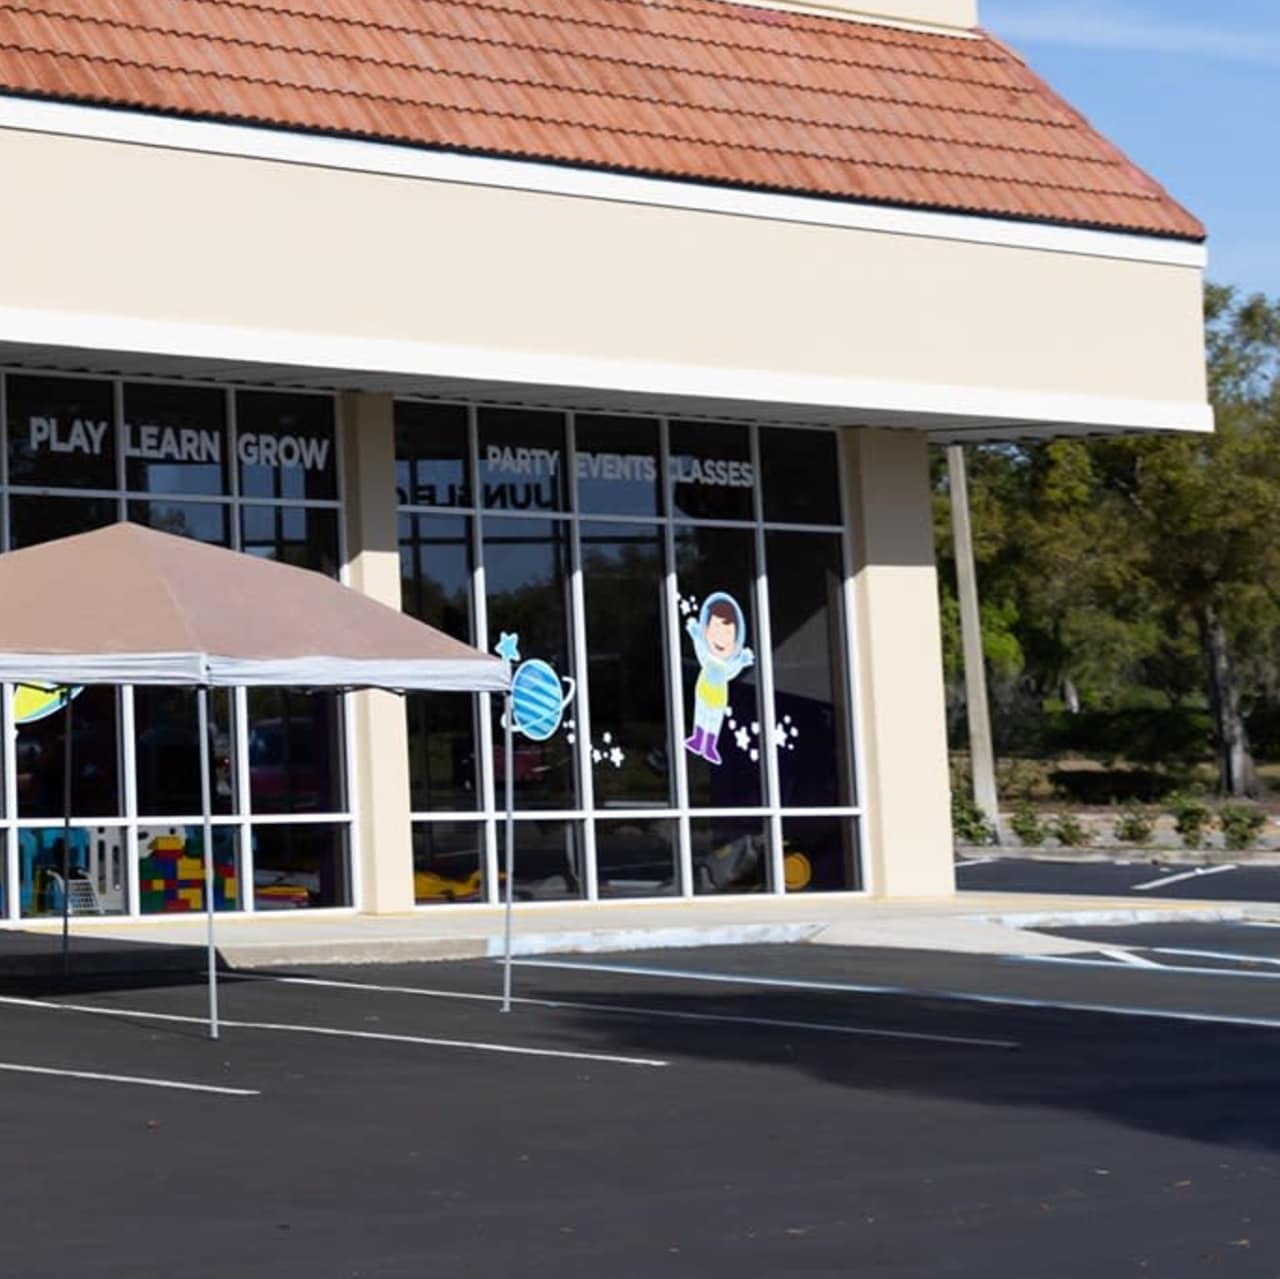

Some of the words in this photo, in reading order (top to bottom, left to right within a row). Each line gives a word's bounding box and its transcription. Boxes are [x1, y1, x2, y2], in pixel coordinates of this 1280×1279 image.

[29, 416, 108, 455] PLAY
[124, 423, 221, 463] LEARN
[238, 432, 330, 471] GROW
[486, 444, 561, 477] PARTY
[573, 451, 658, 482] EVENTS
